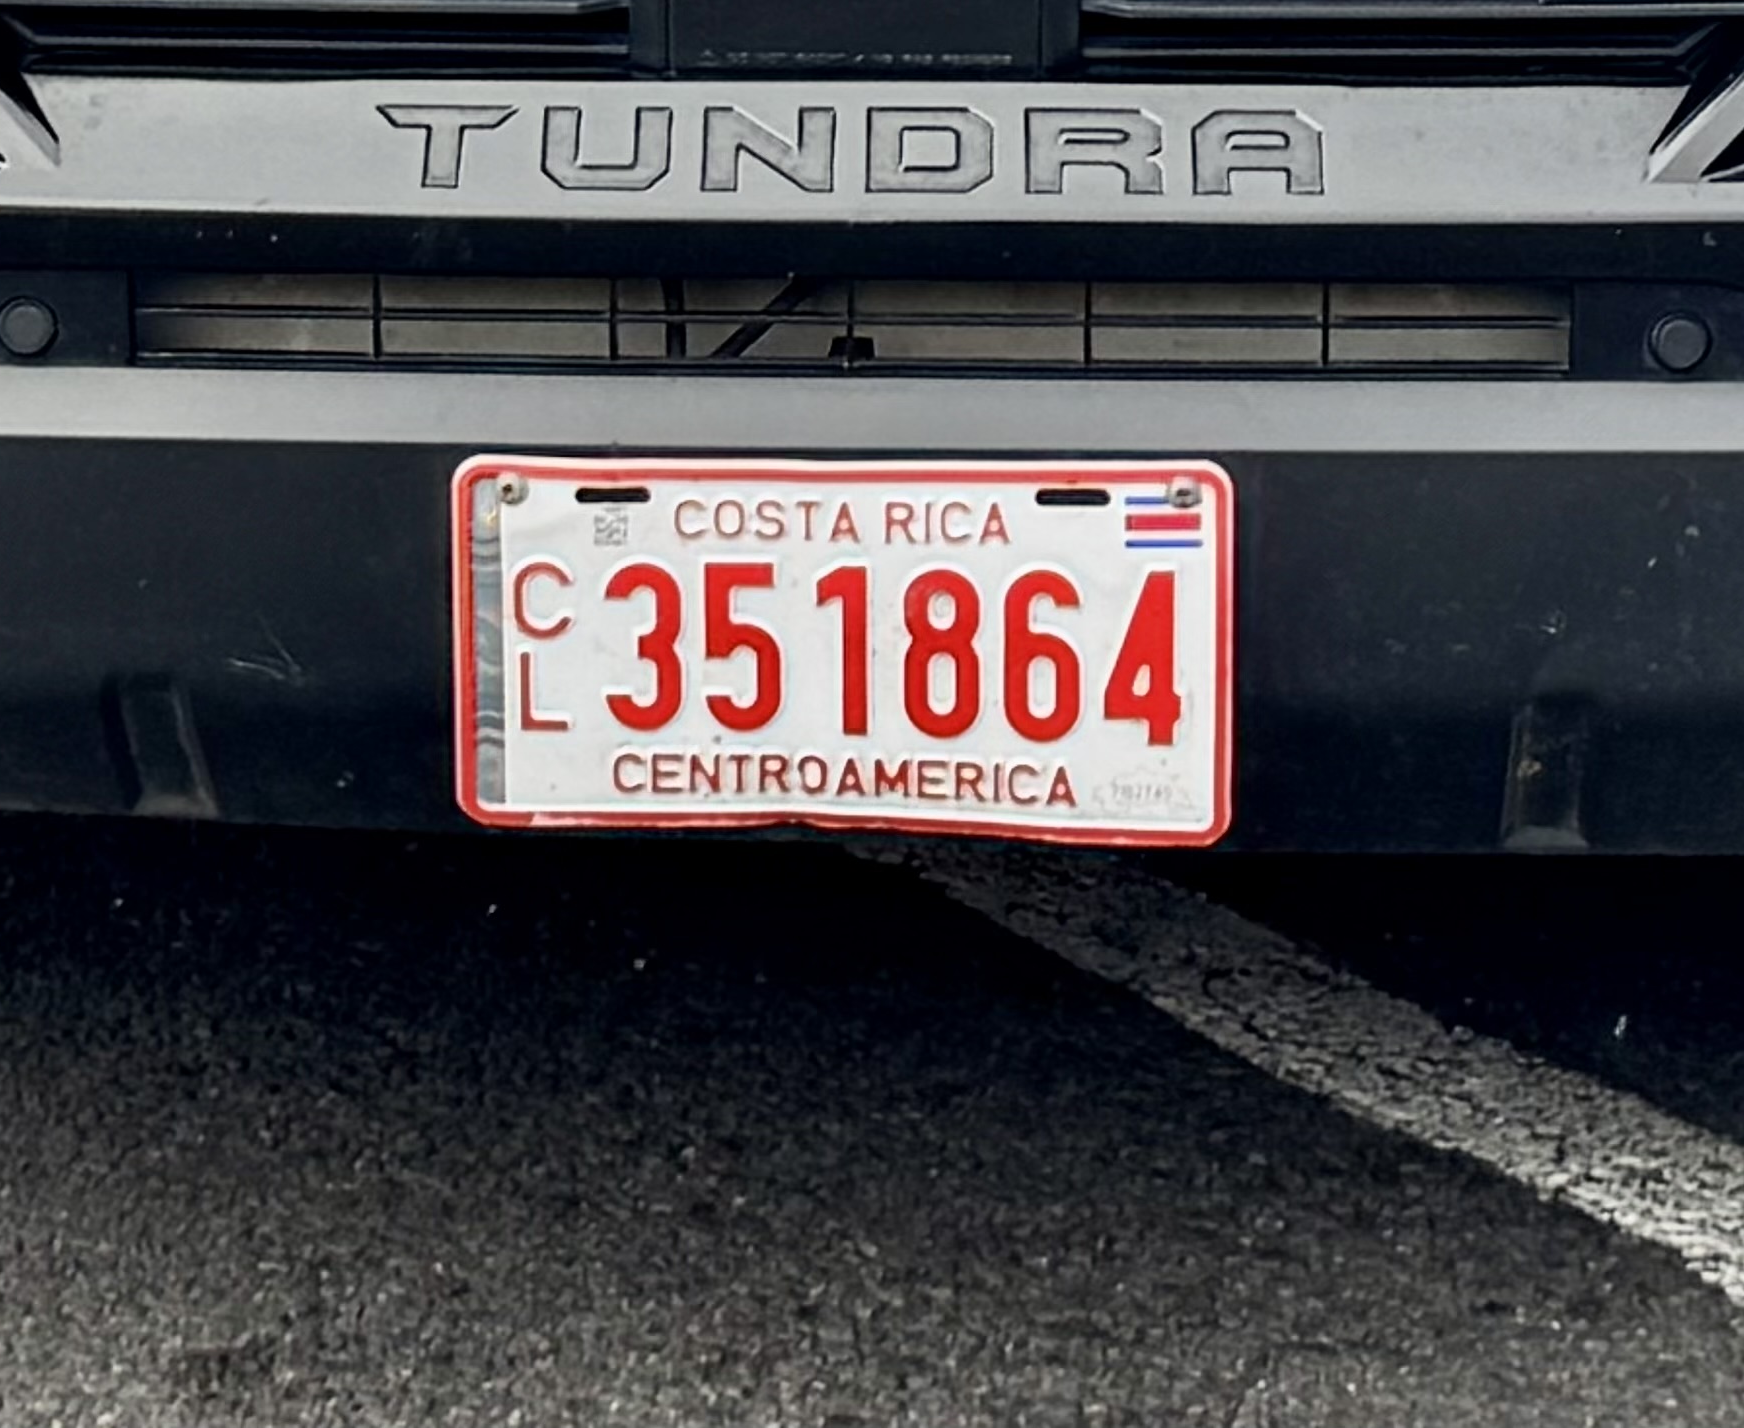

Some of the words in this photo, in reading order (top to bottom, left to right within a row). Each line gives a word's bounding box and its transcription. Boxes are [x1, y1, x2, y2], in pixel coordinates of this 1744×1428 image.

[375, 103, 1326, 197] TUNDRA
[673, 499, 857, 544] COSTA
[884, 500, 1012, 546] RICA
[604, 561, 1183, 747] 351864
[612, 752, 1078, 808] CENTROAMERICA
